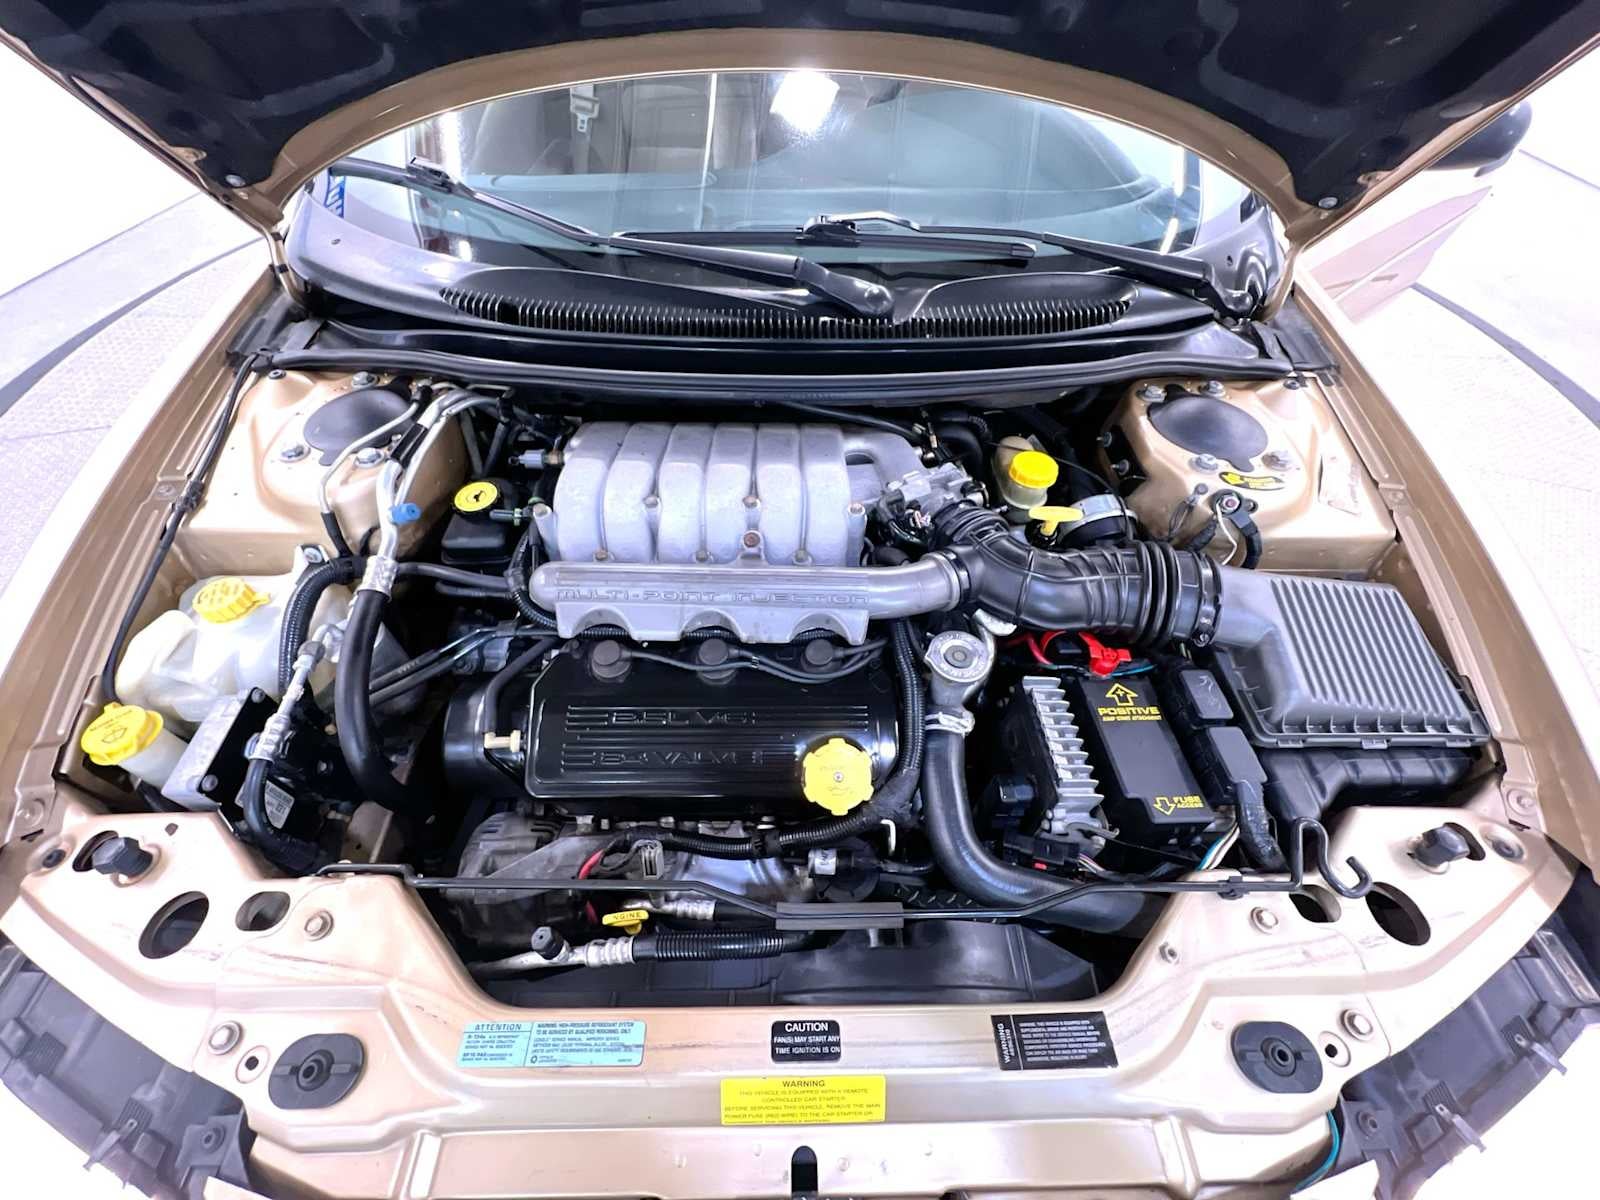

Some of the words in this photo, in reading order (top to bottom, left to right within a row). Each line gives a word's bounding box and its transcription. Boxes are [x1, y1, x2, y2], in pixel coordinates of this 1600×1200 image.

[732, 592, 870, 604] INJECTION
[1097, 707, 1160, 715] POSITIVE
[474, 1023, 522, 1031] ATTENTION
[785, 1022, 829, 1032] CAUTION
[808, 1035, 827, 1043] START
[997, 1023, 1011, 1063] WARNING
[791, 1046, 821, 1054] IGNITION
